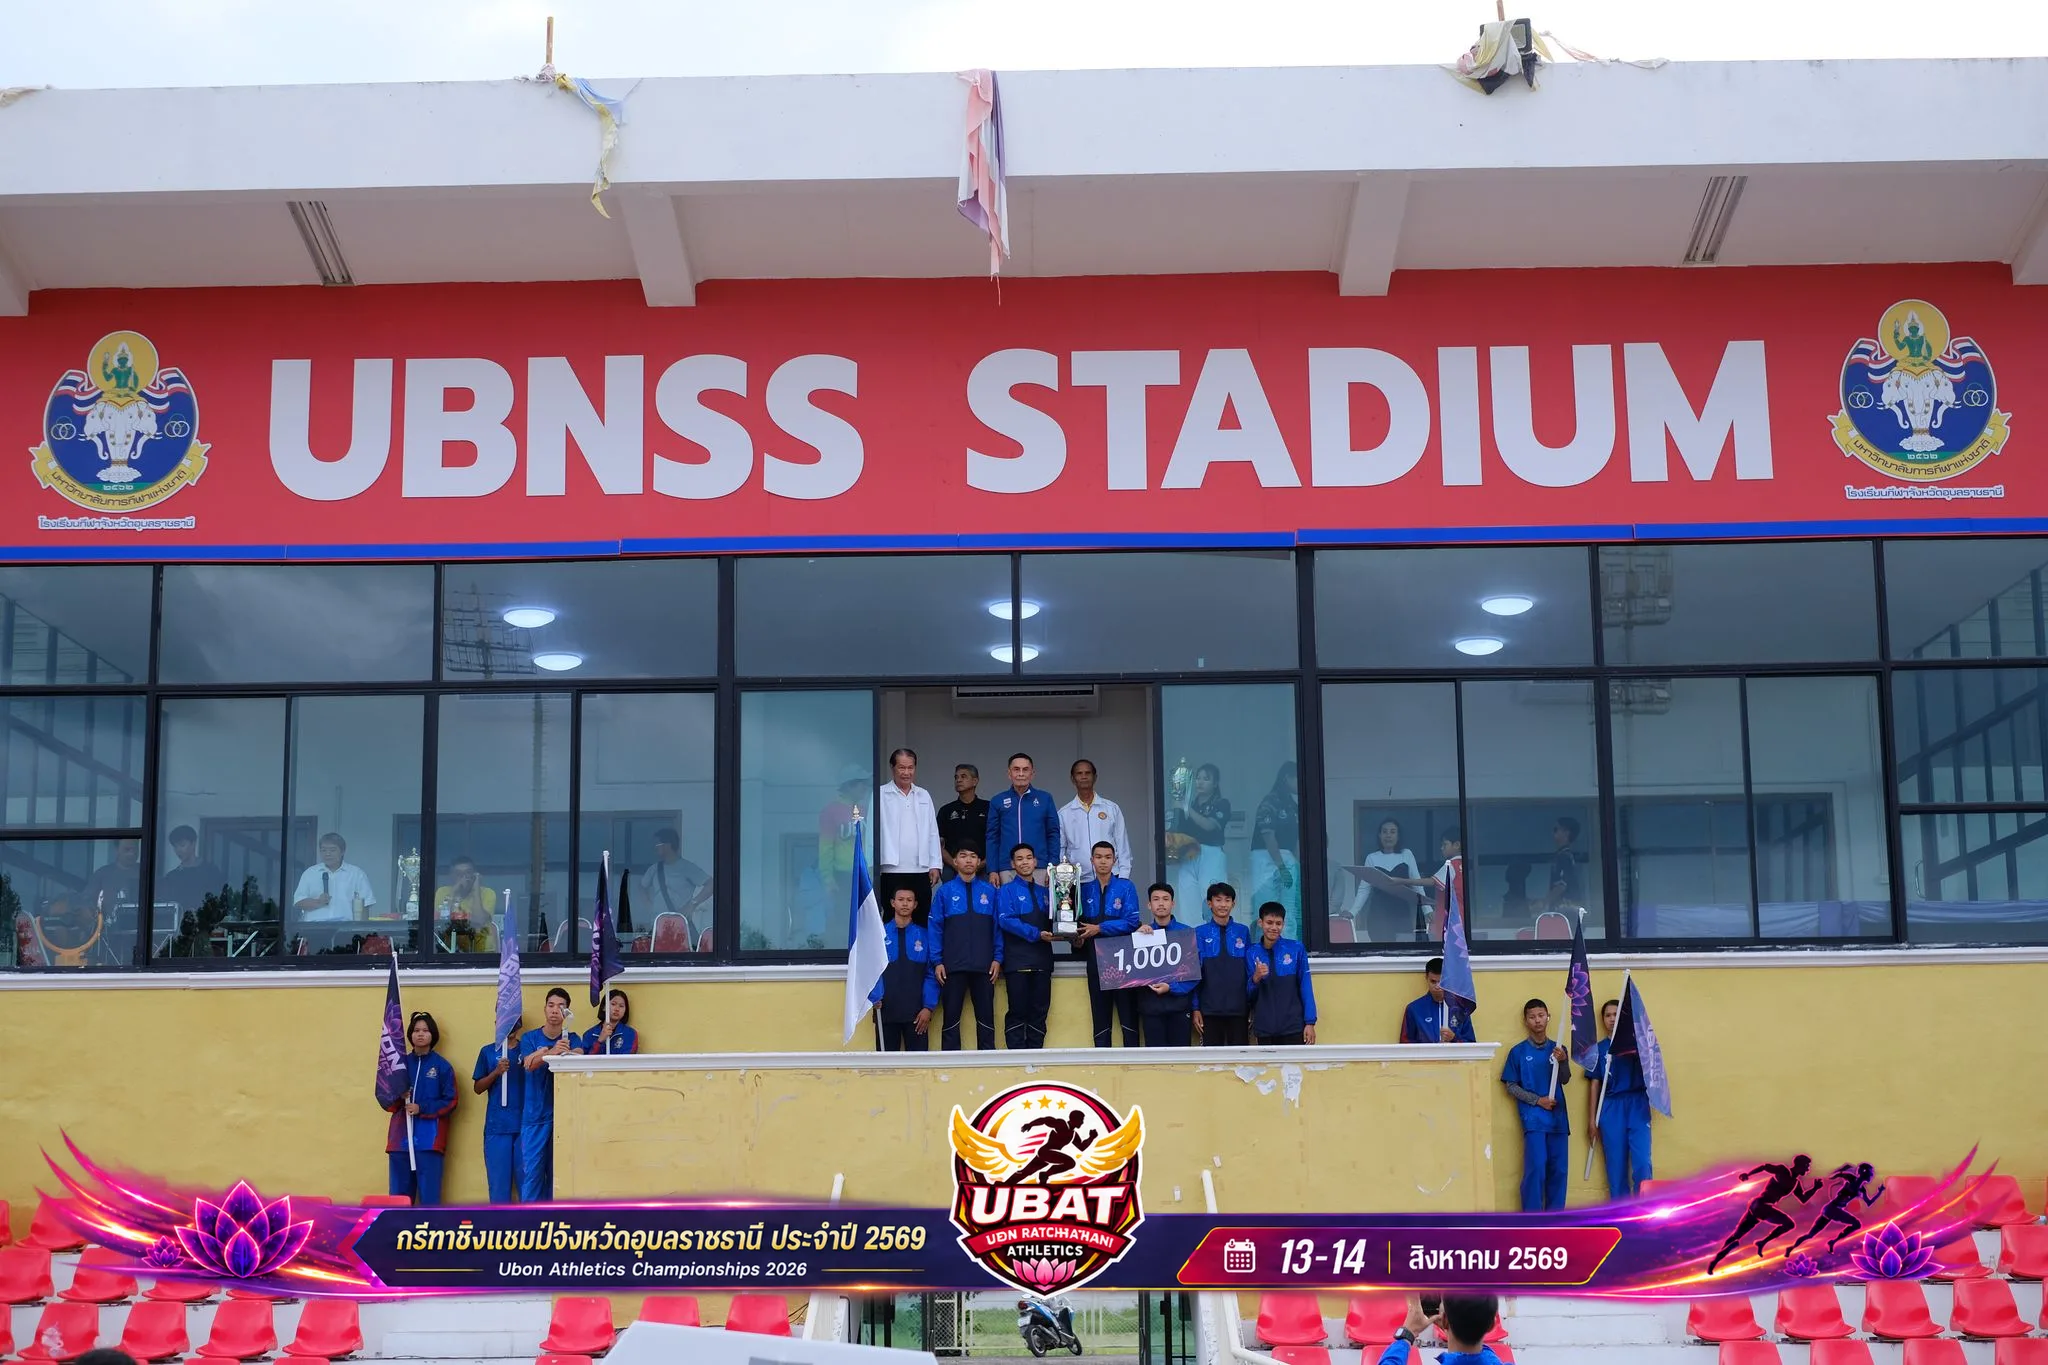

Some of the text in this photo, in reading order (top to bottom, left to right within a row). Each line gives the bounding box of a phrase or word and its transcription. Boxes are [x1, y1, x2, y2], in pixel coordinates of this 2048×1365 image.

[268, 339, 1774, 501] UBNSS STADIUM
[1113, 942, 1182, 974] 1,000
